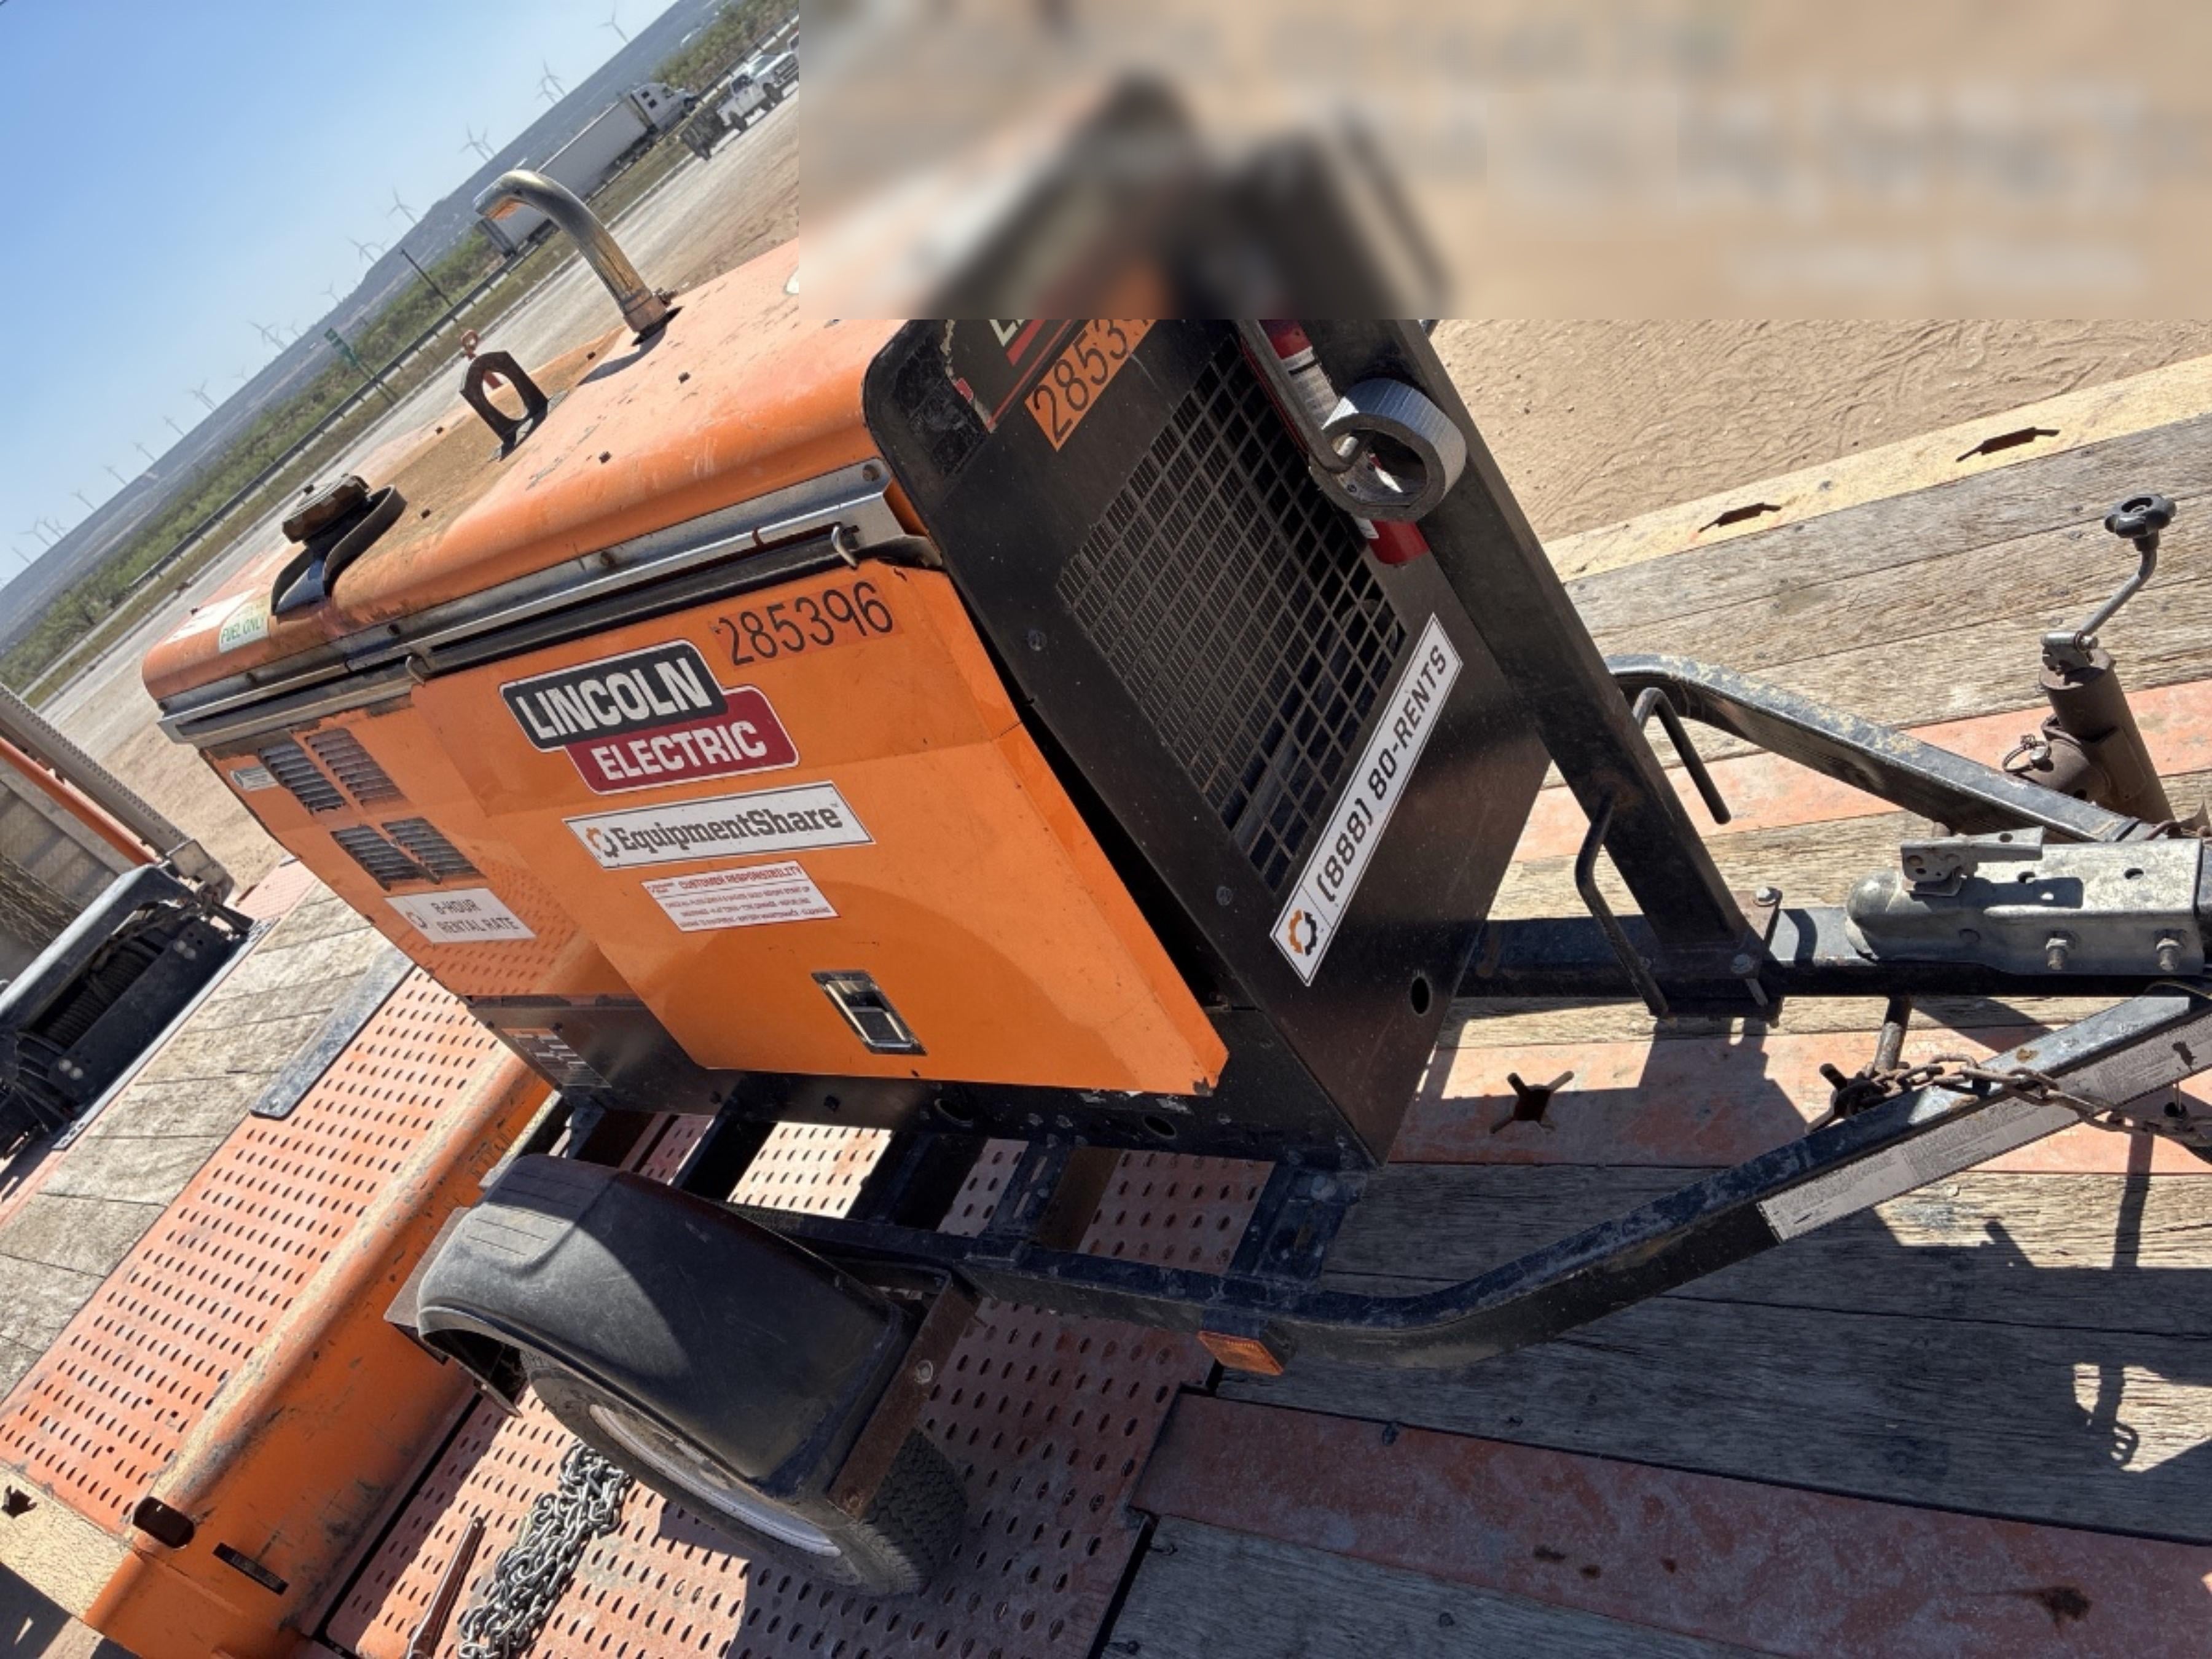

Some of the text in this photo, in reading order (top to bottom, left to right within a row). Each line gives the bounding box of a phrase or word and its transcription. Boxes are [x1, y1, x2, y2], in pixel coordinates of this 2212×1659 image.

[1033, 320, 1148, 442] 2853
[718, 581, 892, 665] 285396
[516, 657, 712, 740] LINCOLN
[591, 720, 767, 780] ELECTRIC
[1317, 645, 1446, 902] (888) 80-RENTS
[610, 807, 843, 853] EquipmentShare
[482, 917, 520, 931] RATE
